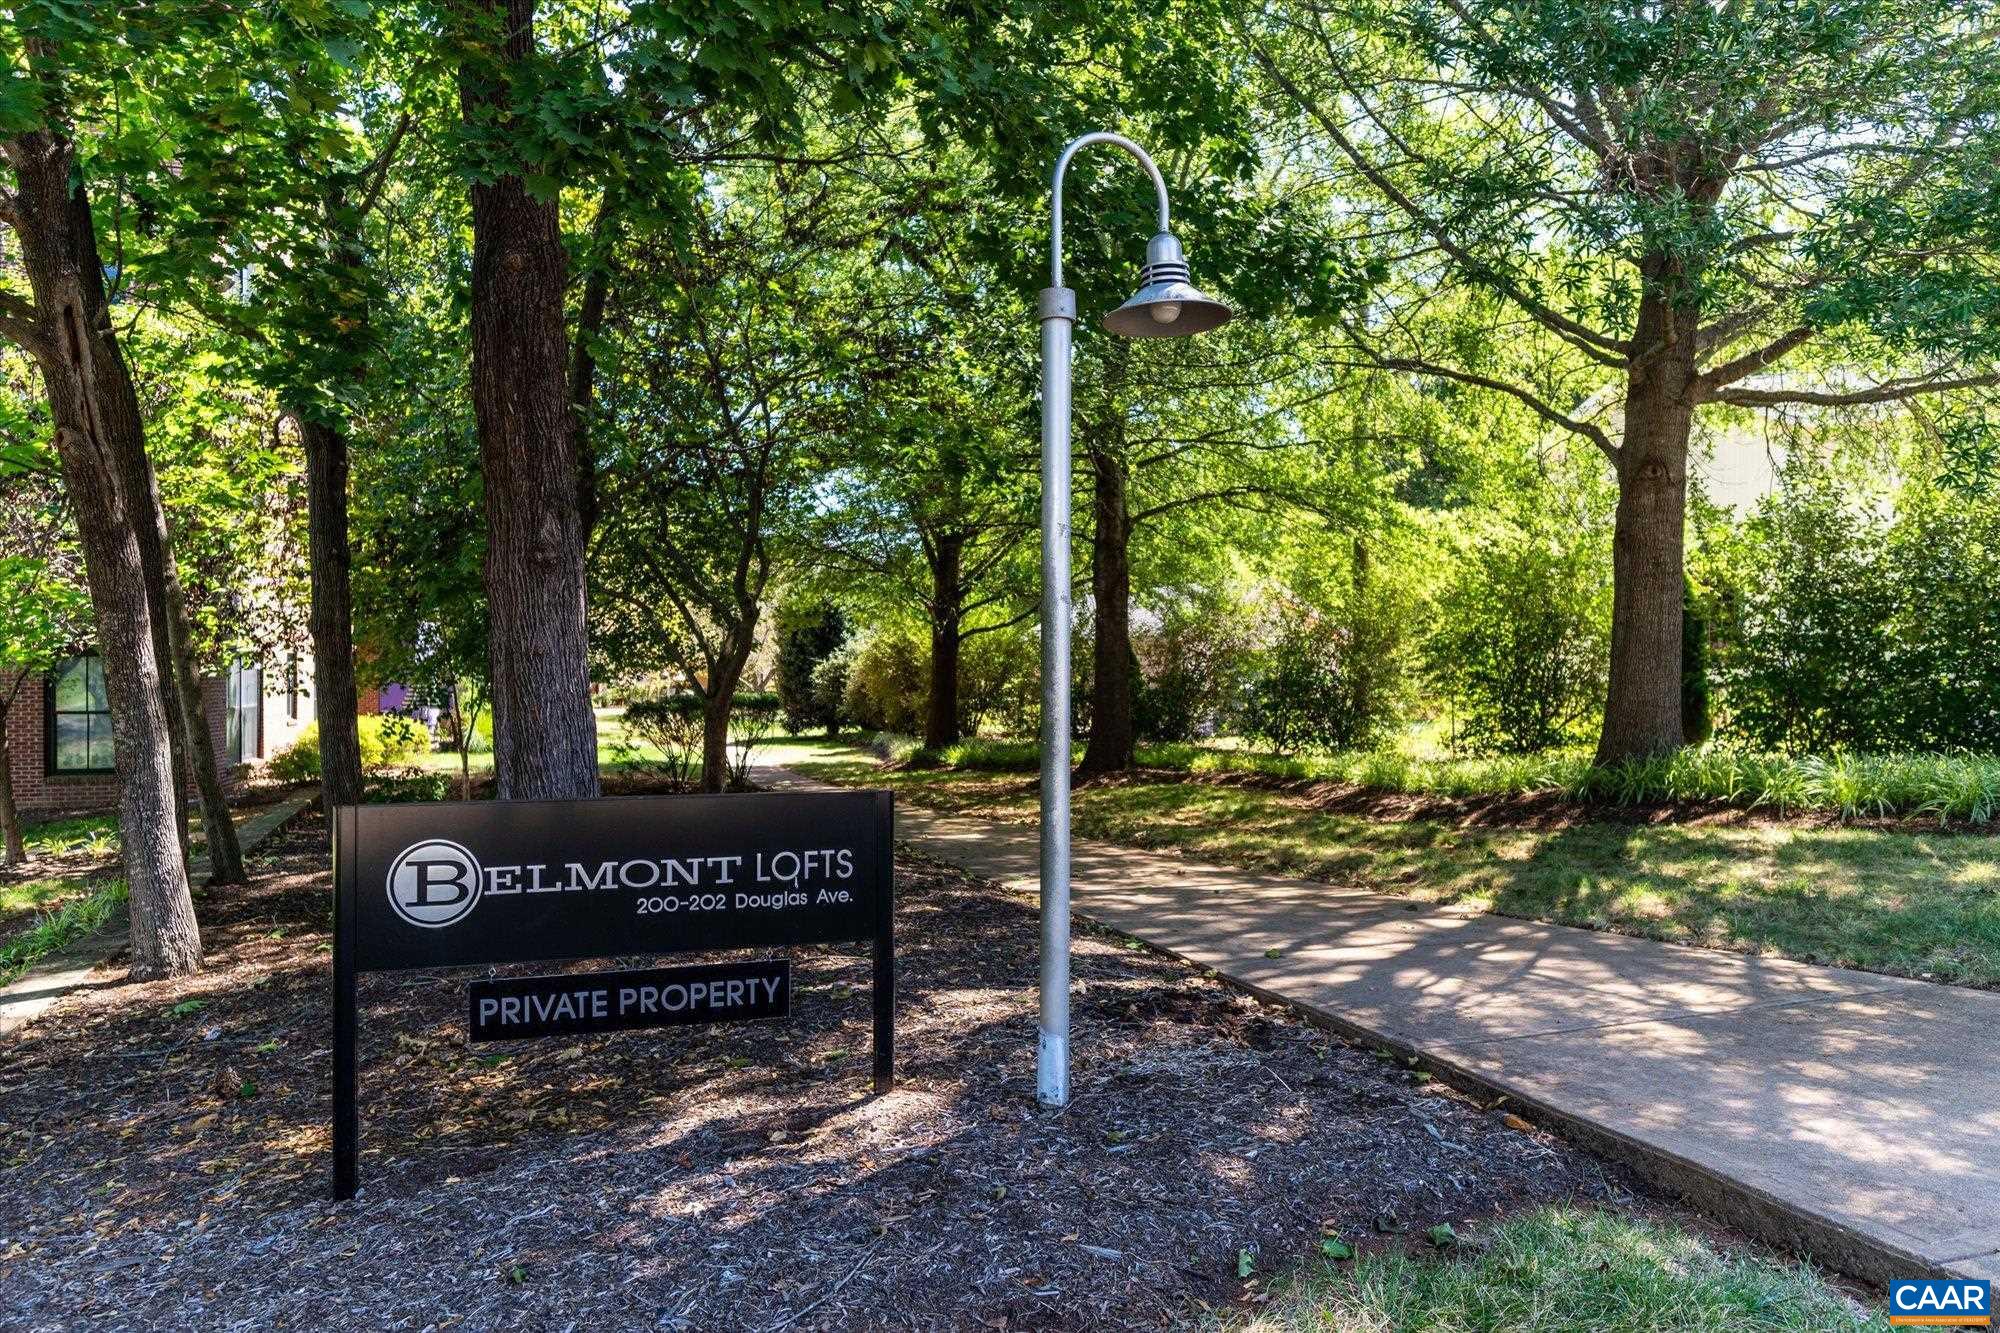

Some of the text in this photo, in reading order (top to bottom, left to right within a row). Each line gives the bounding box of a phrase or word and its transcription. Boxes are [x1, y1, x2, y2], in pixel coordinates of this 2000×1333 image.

[403, 849, 854, 909] BELMONT LOFTS
[636, 888, 854, 914] 200-202 Douglas Ave.
[479, 976, 781, 1026] PRIVATE PROPERTY
